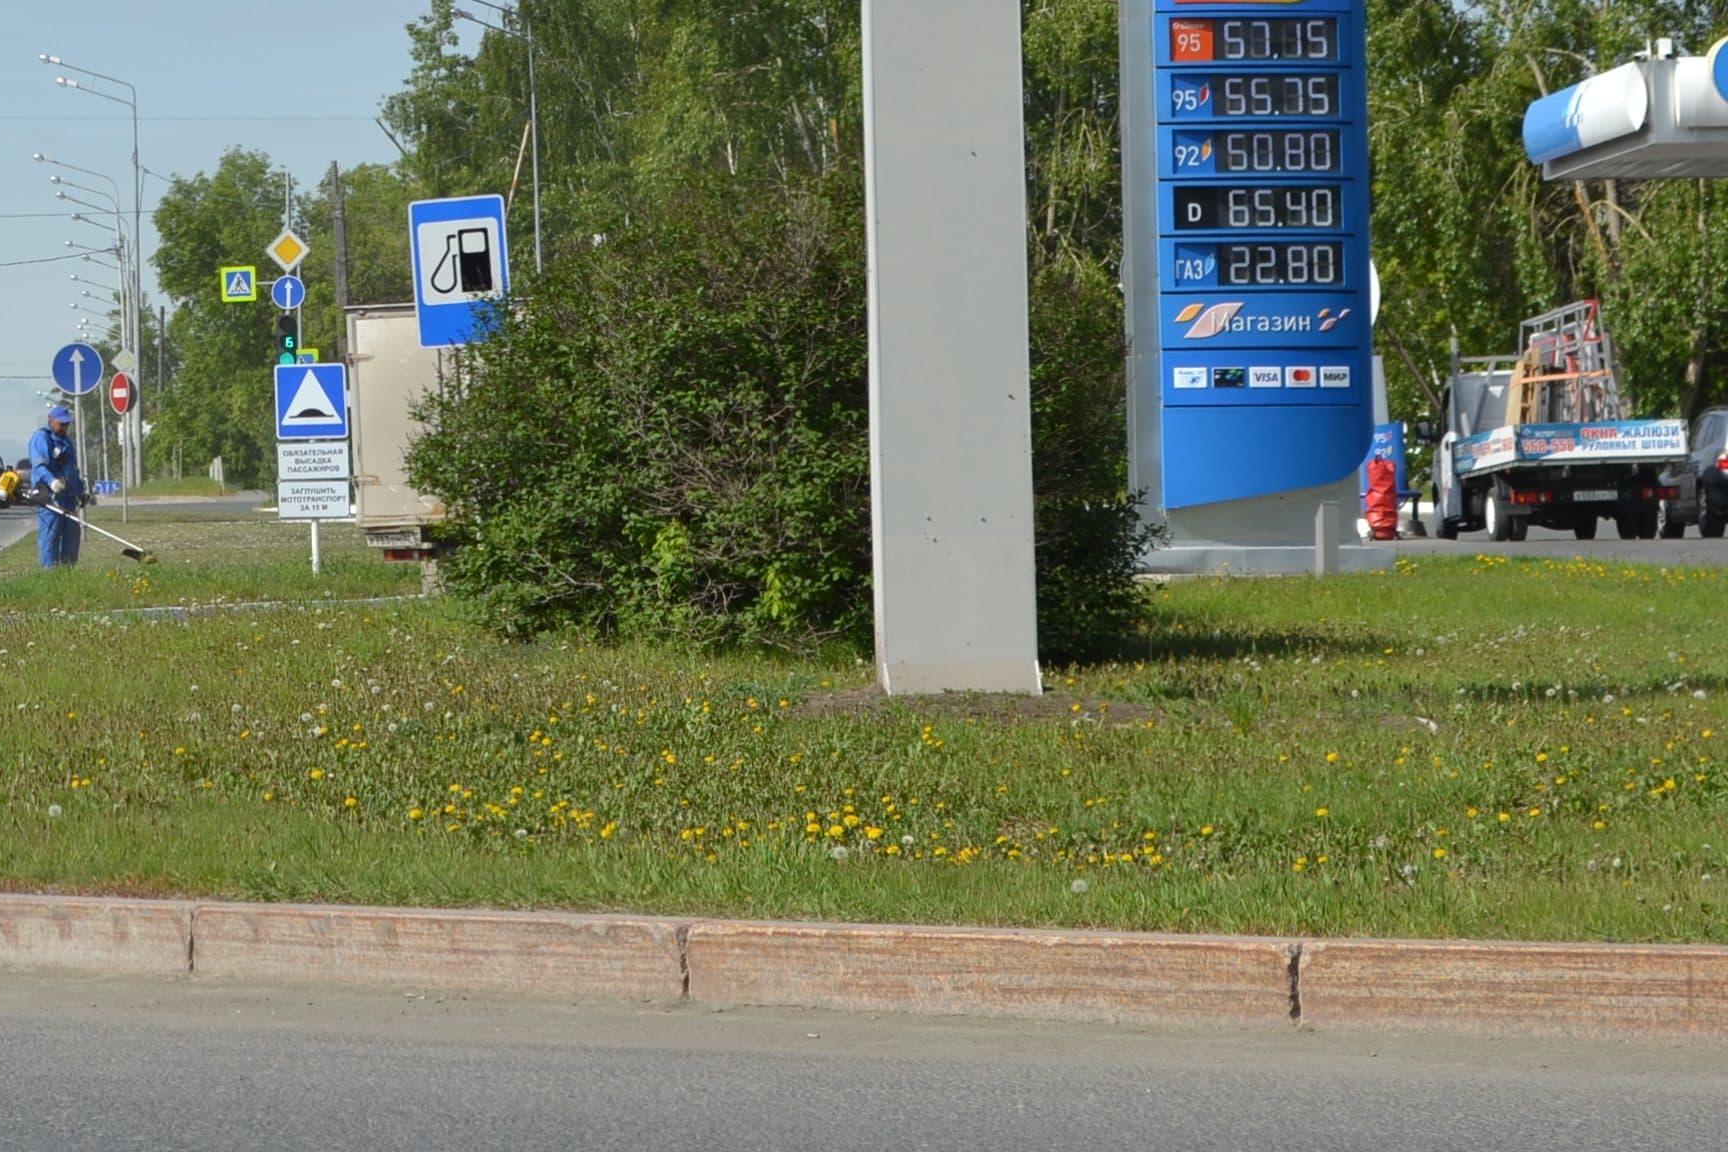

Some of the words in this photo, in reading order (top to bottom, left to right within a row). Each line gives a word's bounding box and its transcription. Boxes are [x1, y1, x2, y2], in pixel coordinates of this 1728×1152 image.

[1177, 33, 1201, 53] 95
[1223, 20, 1328, 60] 57.15
[1172, 89, 1197, 111] 95
[1225, 78, 1330, 116] 55.75
[1174, 146, 1200, 167] 92
[1227, 133, 1331, 171] 50.80
[1187, 203, 1202, 222] D
[1228, 189, 1333, 228] 65.40
[1175, 259, 1204, 281] ГАЗ
[1229, 246, 1334, 284] 22.80
[1210, 311, 1312, 333] Магазин
[1254, 372, 1279, 383] VISA
[1580, 427, 1617, 439] ОКНА
[1622, 425, 1680, 438] ЖАЛЮЗИ
[282, 449, 344, 457] ОБЯЗАТЕЛЬНАЯ
[294, 457, 332, 465] ВЫСАДКА
[287, 465, 340, 473] ПАССАЖИРОВ
[291, 487, 337, 495] ЗАГЛУШИТЬ
[280, 495, 346, 504] МОТОТРАНСПОРТ
